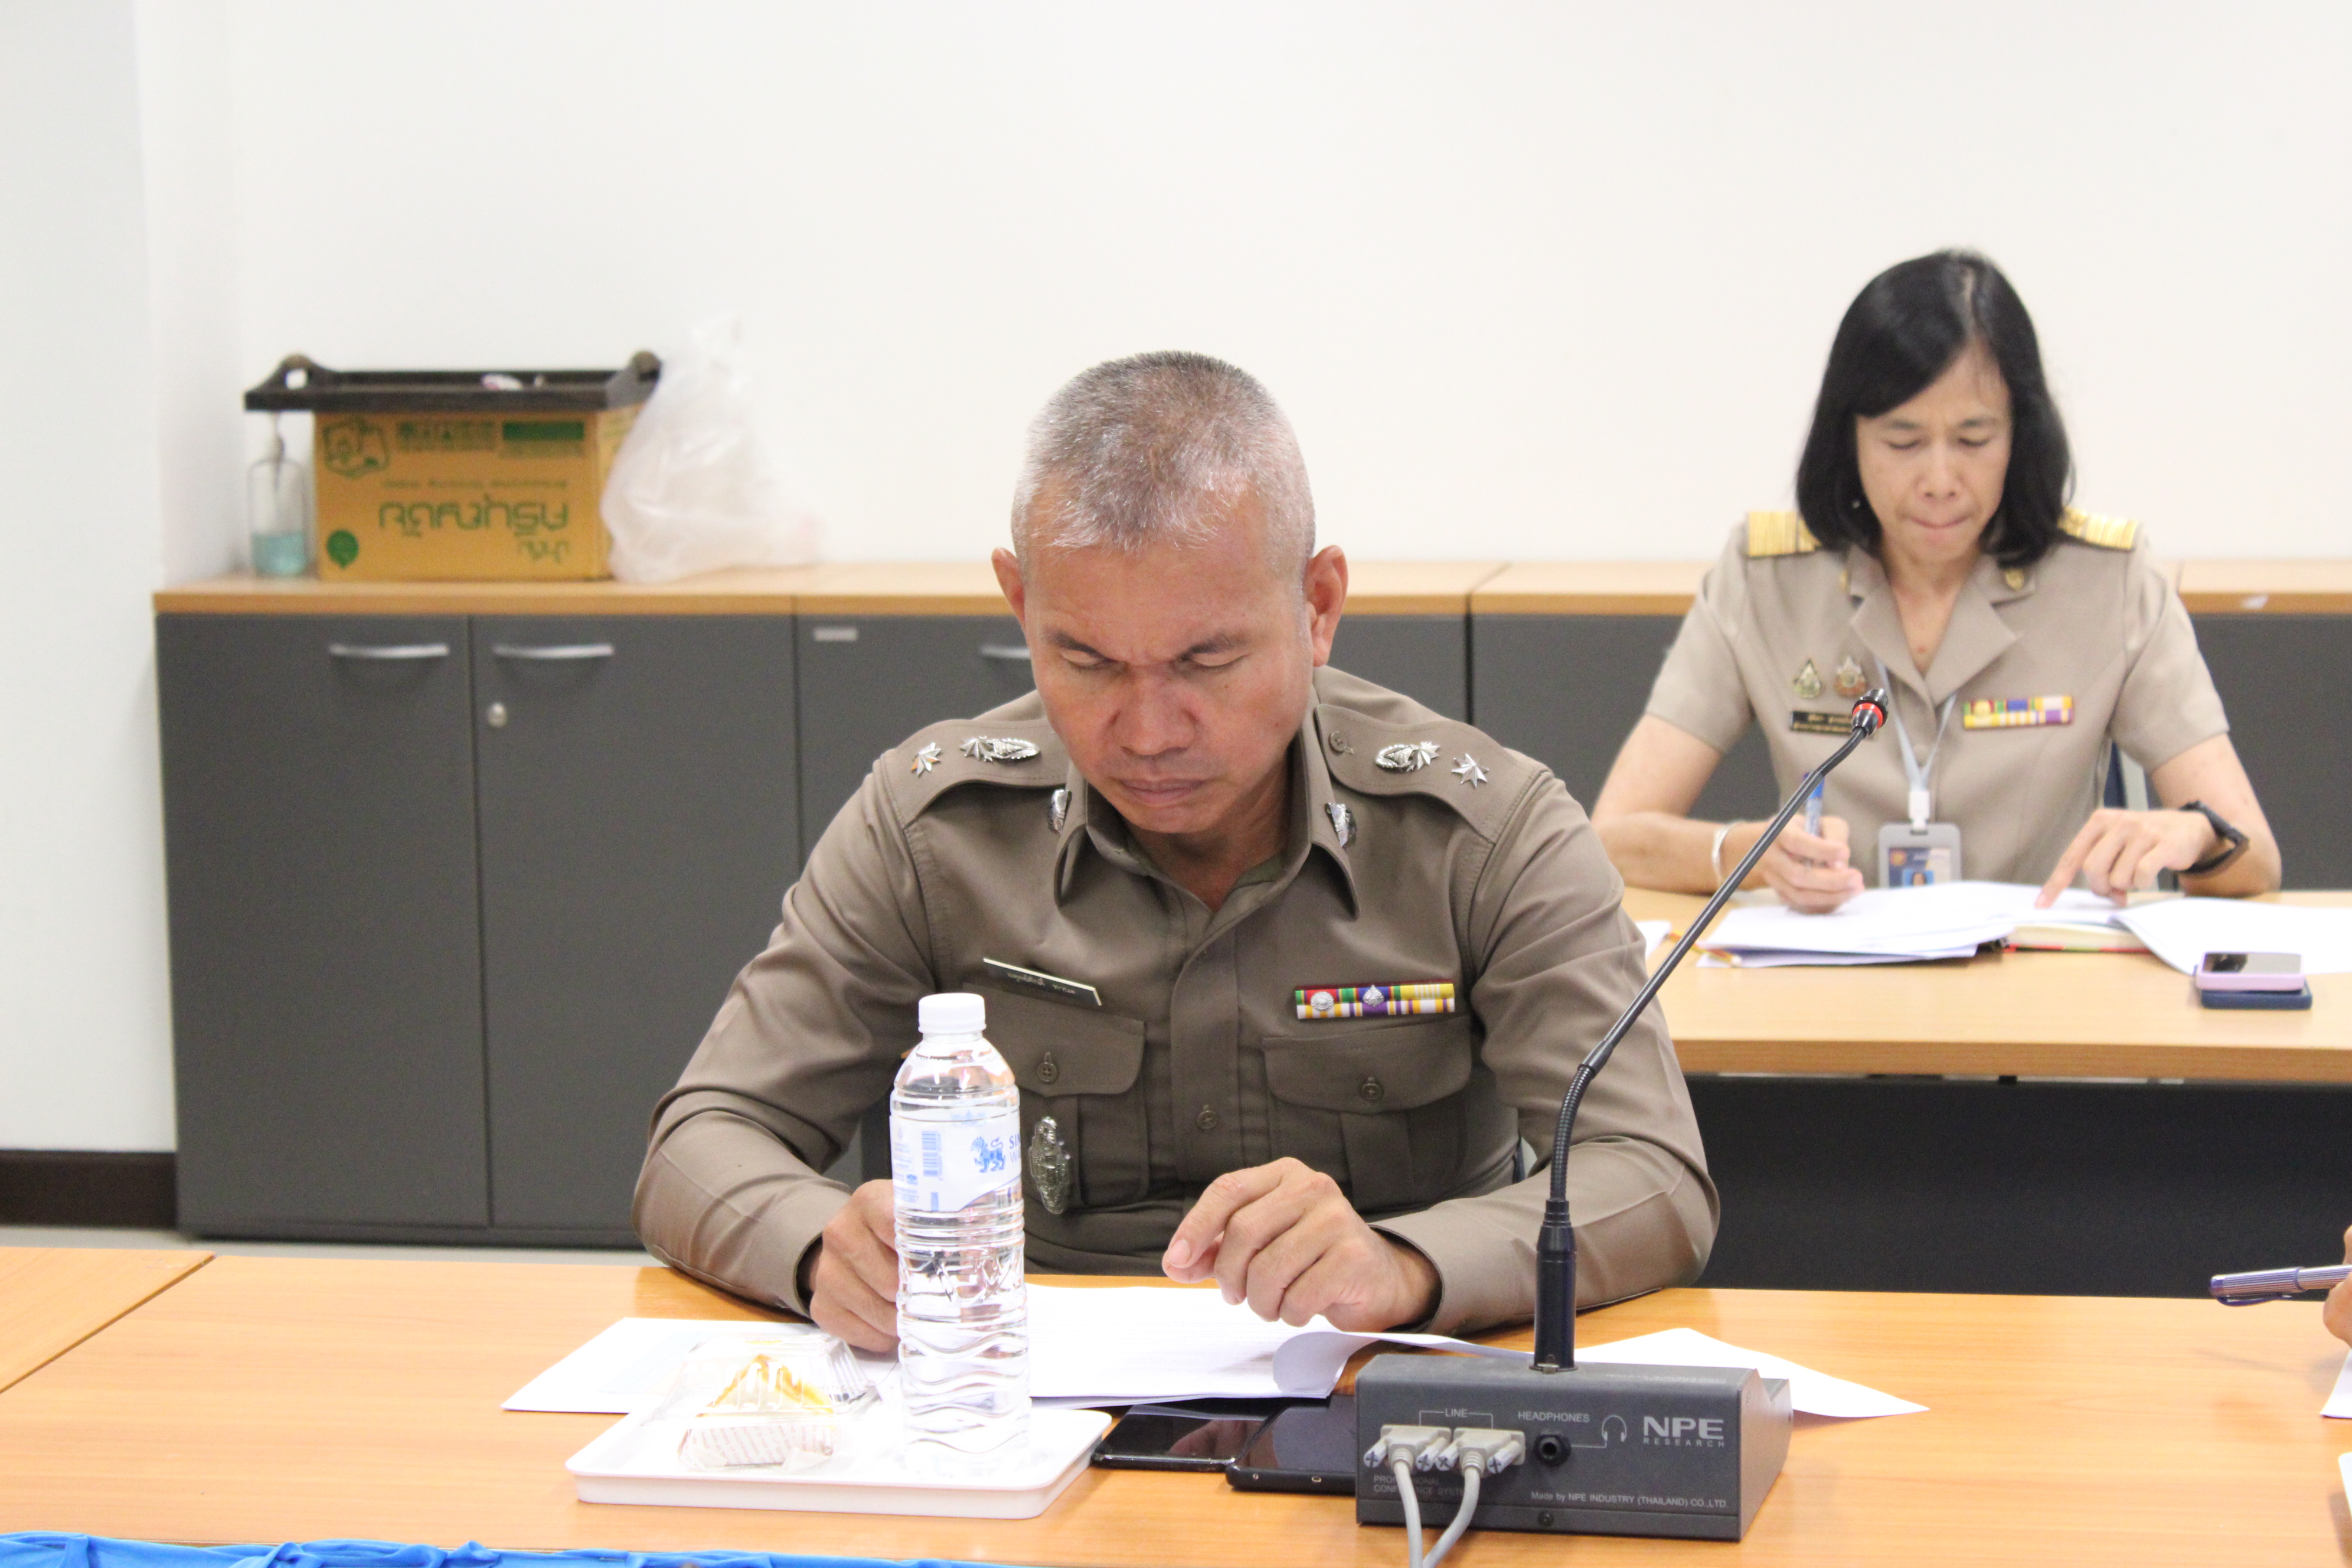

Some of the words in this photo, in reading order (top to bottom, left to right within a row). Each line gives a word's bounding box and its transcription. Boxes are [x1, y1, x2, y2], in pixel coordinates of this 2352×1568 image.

[1445, 1408, 1468, 1417] LINE
[1518, 1411, 1590, 1423] HEADPHONES
[1644, 1416, 1724, 1440] NPE
[1644, 1438, 1724, 1448] RESEARCH
[1531, 1491, 1553, 1500] Made
[1556, 1493, 1566, 1502] by
[1569, 1493, 1586, 1502] NPE
[1590, 1494, 1635, 1504] INDUSTRY
[1638, 1495, 1688, 1507] (THAILAND)
